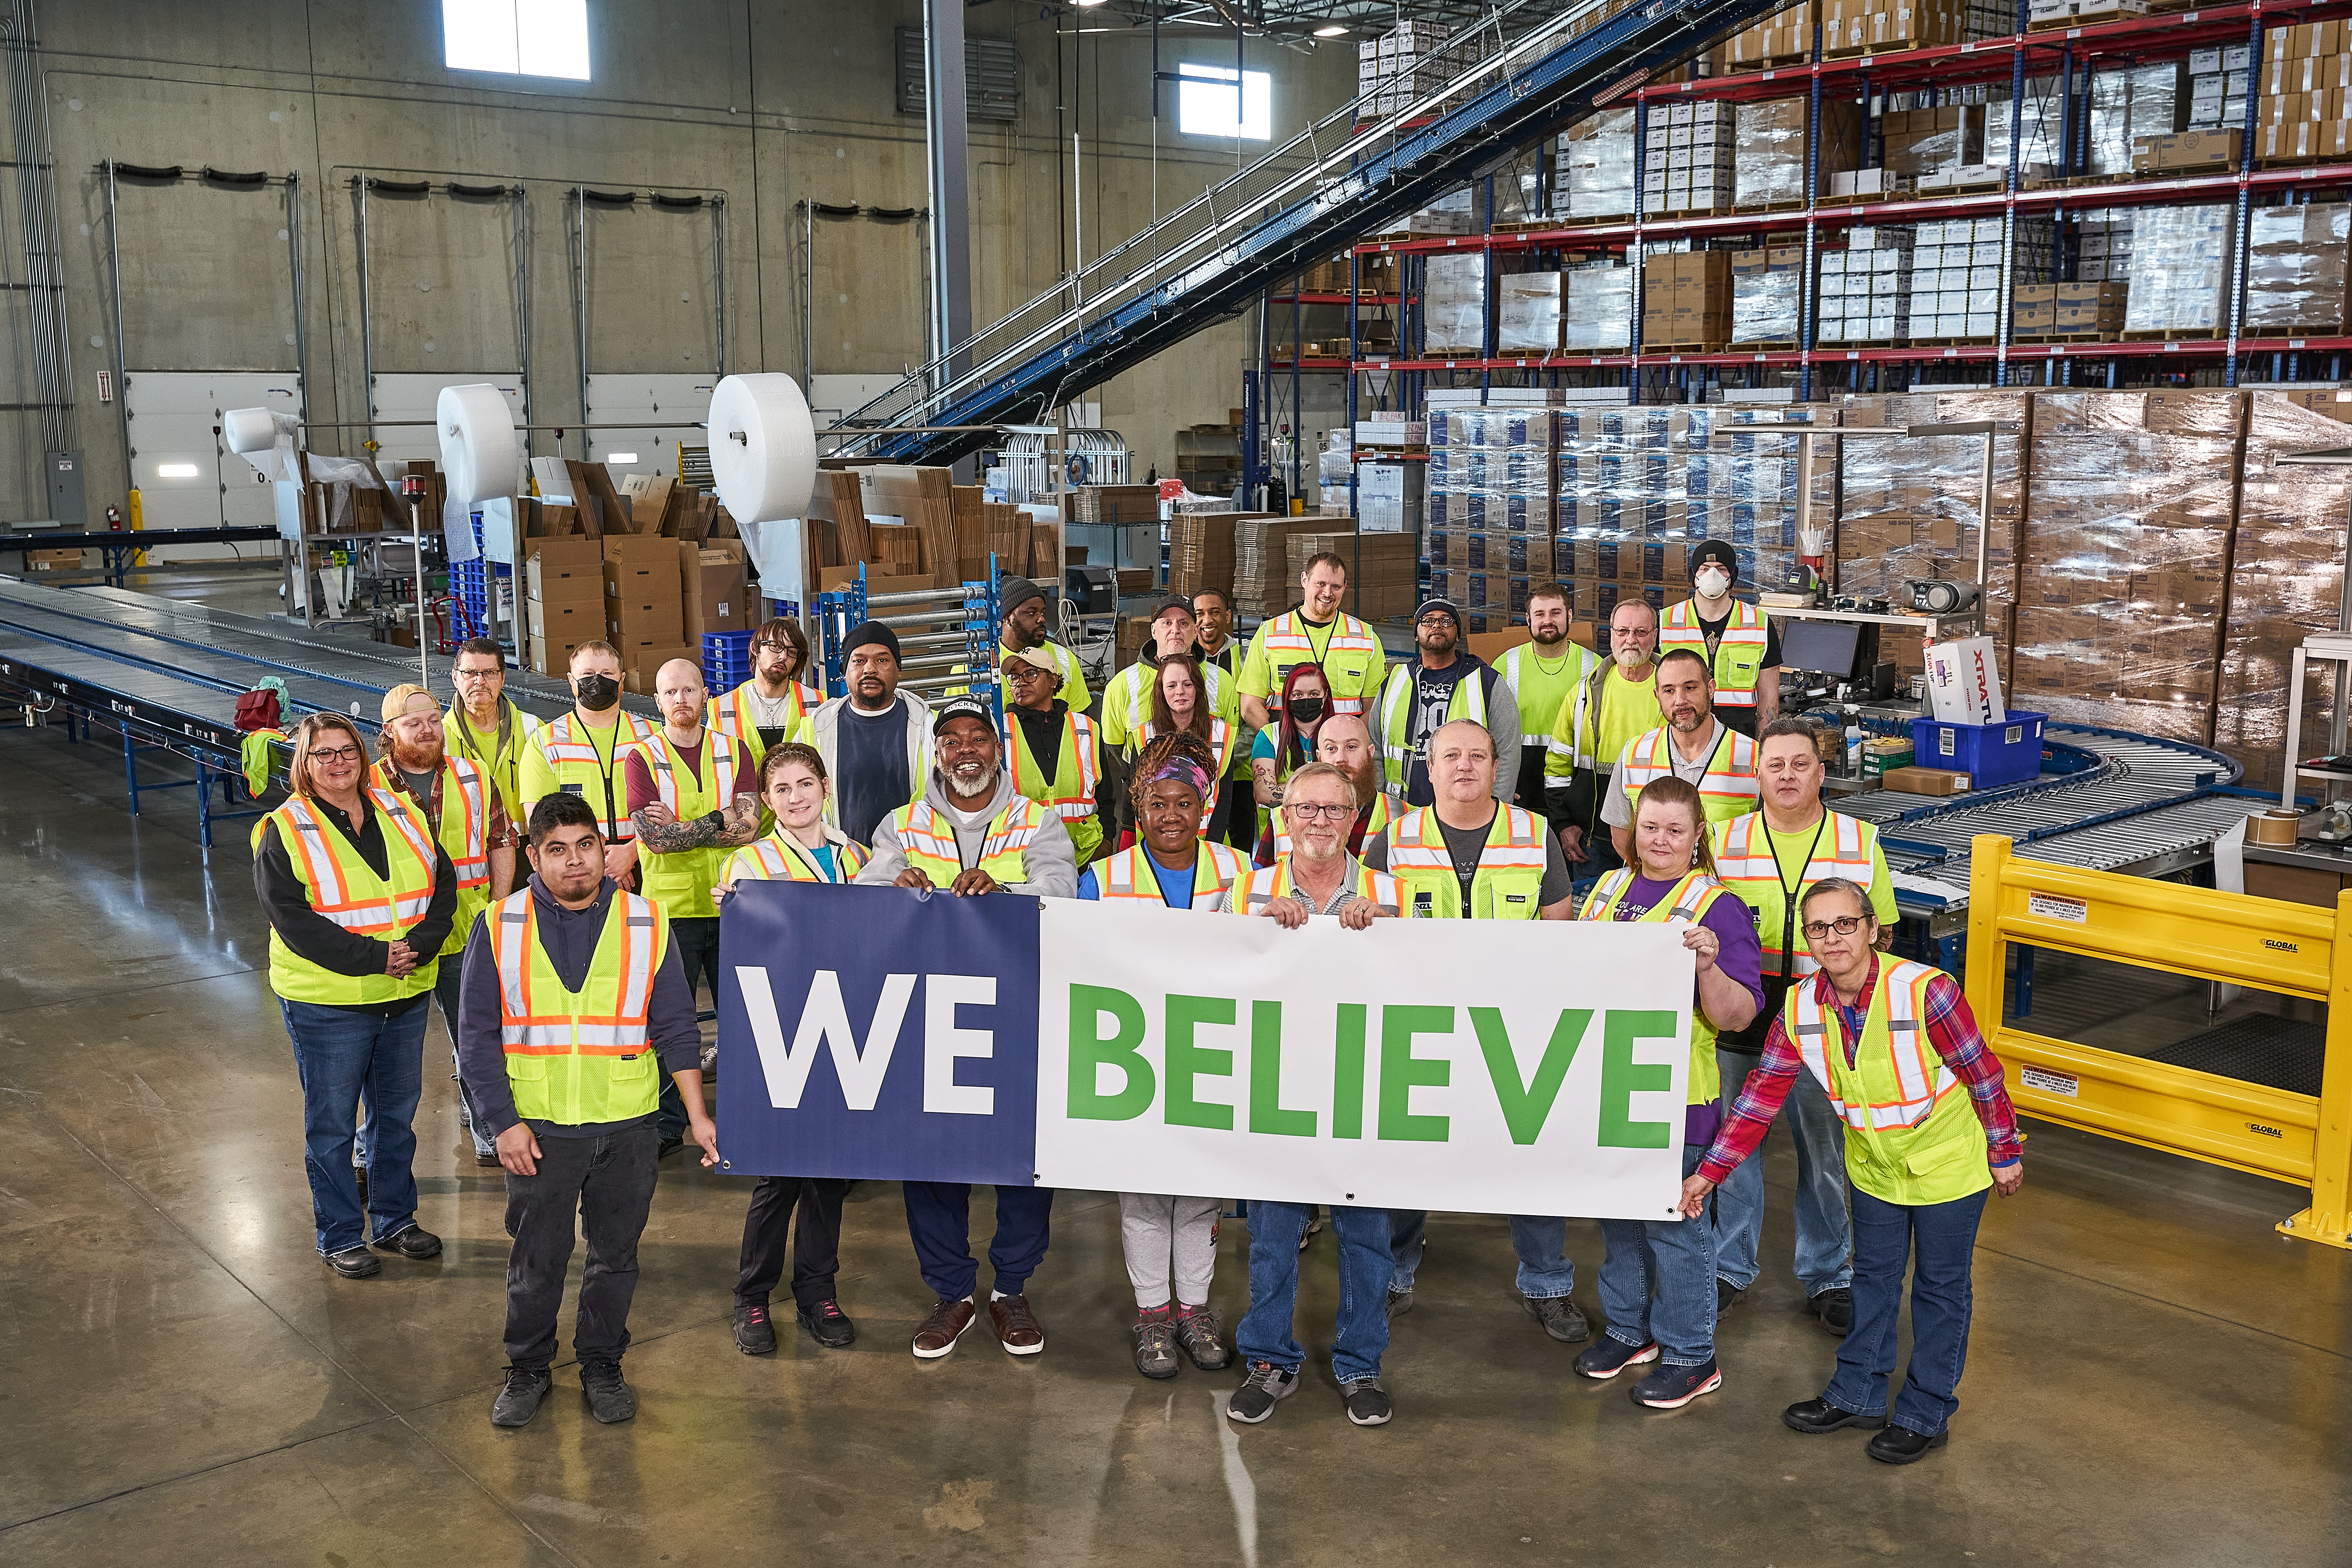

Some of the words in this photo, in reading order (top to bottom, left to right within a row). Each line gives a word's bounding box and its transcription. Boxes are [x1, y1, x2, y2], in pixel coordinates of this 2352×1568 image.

[2002, 622, 2007, 632] MB
[946, 702, 980, 712] ROCKET
[2042, 895, 2075, 904] WARNING
[1629, 904, 1648, 914] ARE
[2266, 940, 2298, 951] GLOBAL
[735, 966, 996, 1114] WE
[1068, 984, 1676, 1148] BELIEVE
[2033, 1067, 2067, 1078] WARNING
[2251, 1124, 2283, 1136] GLOBAL
